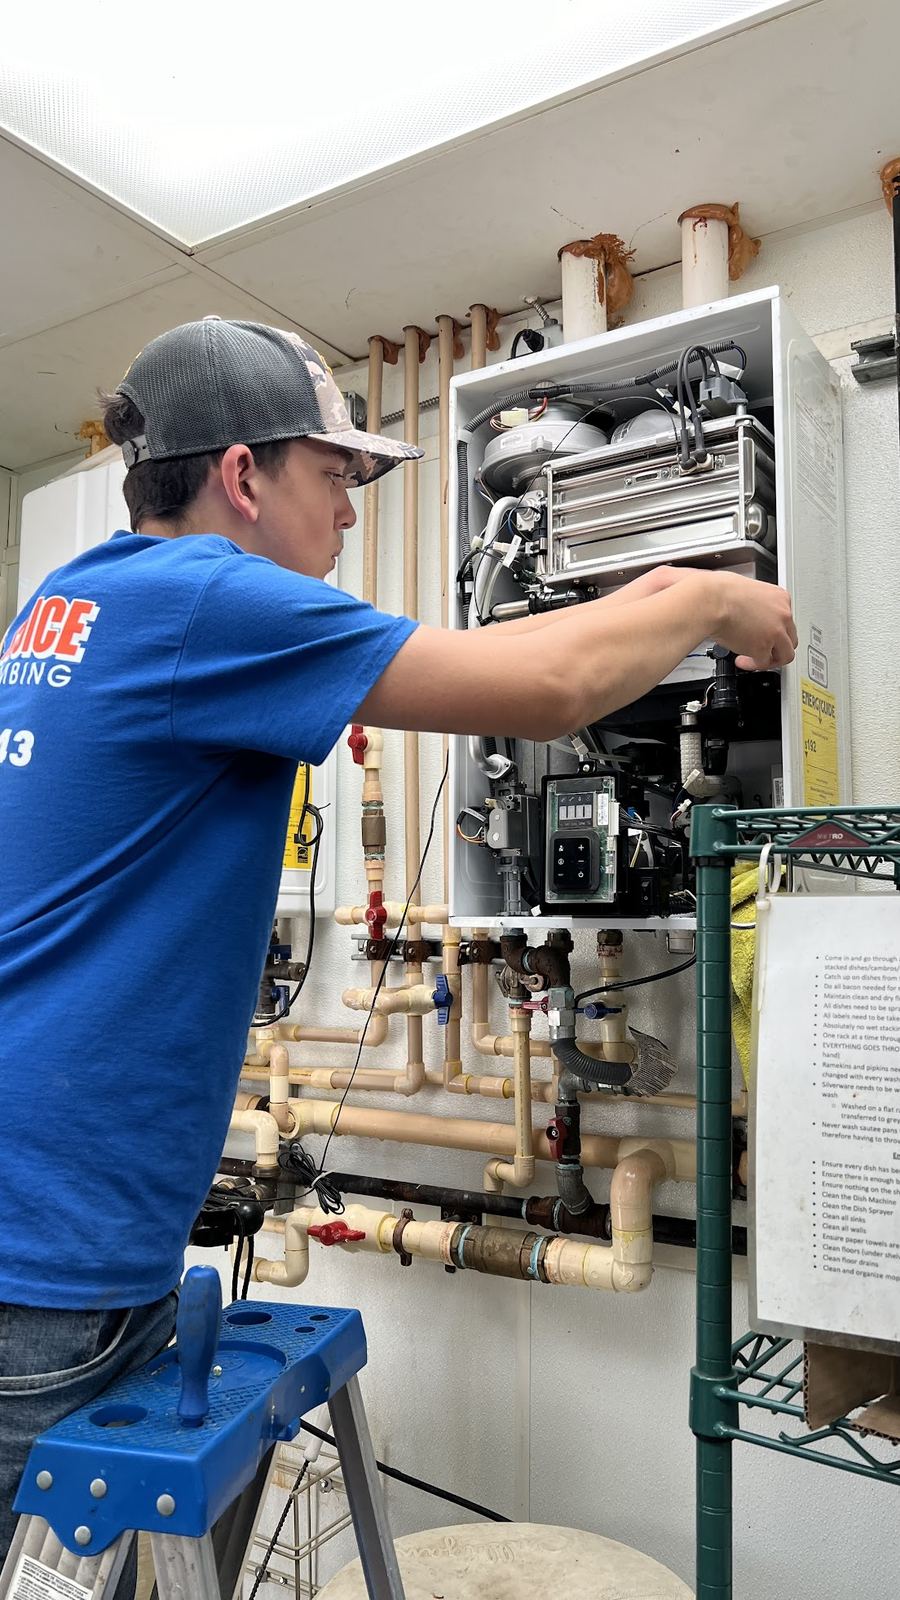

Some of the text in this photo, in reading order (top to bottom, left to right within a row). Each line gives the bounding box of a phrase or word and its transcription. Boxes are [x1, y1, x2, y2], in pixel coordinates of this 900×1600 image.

[841, 1113, 876, 1122] transferred
[853, 1134, 874, 1143] having
[845, 1184, 869, 1193] nothing
[869, 1197, 896, 1205] Machine
[869, 1207, 894, 1216] Sprayer
[822, 1233, 844, 1242] Ensure
[859, 1260, 879, 1268] drains
[856, 1270, 883, 1279] organize
